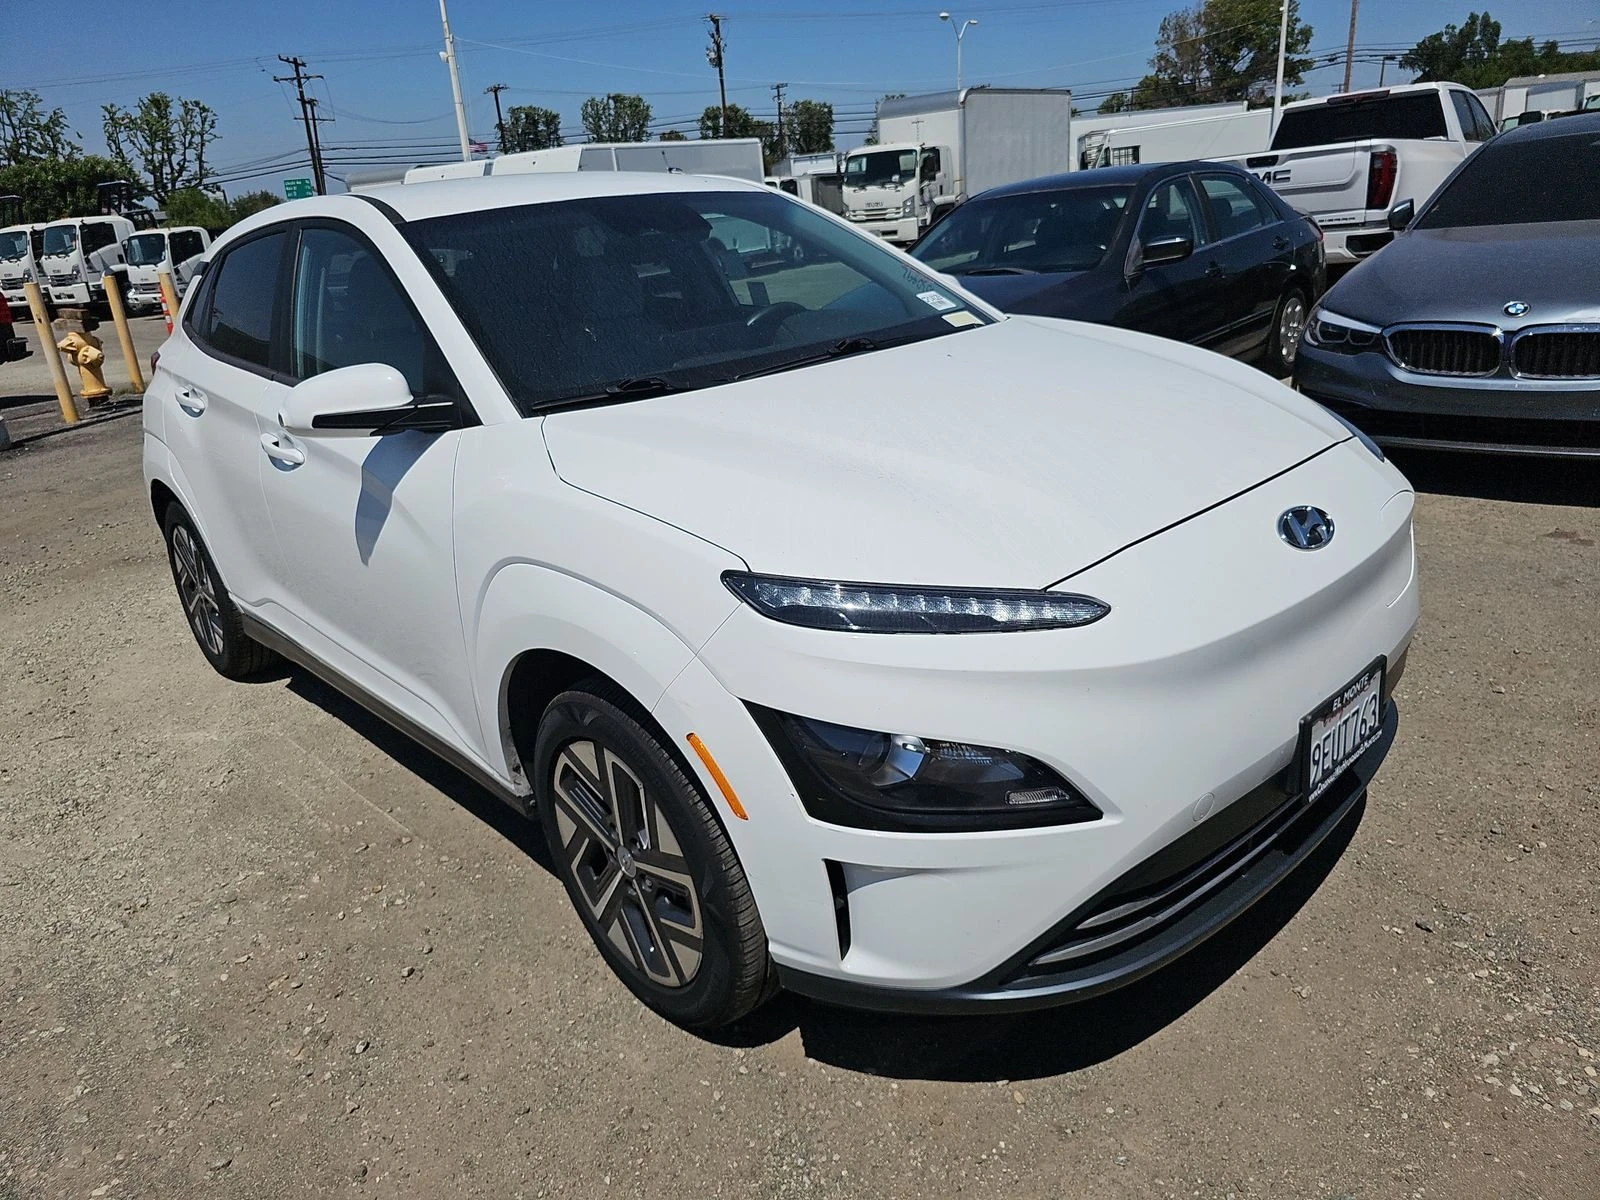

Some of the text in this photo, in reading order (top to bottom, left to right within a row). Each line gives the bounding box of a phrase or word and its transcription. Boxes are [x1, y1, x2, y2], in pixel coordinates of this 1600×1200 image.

[1252, 169, 1291, 184] MC
[1332, 673, 1370, 712] EL MONTE
[1311, 691, 1379, 787] 9EUT763
